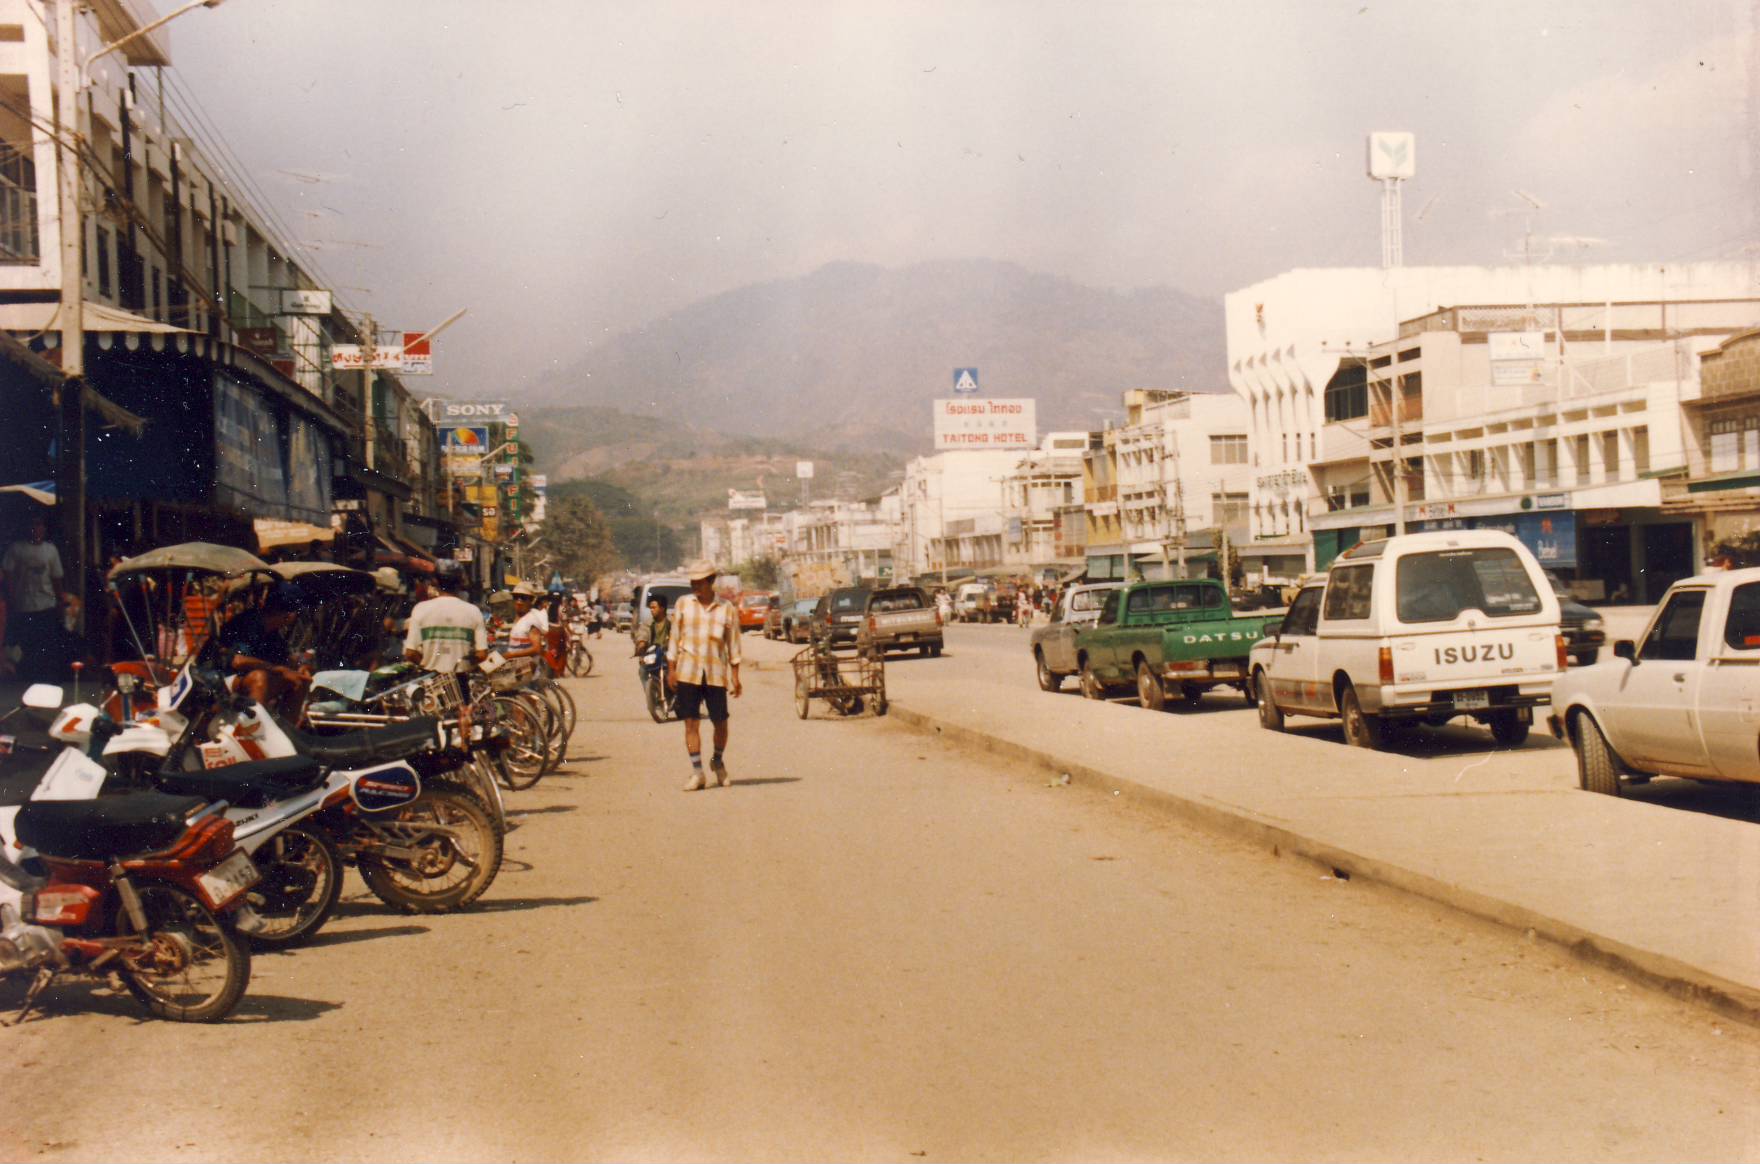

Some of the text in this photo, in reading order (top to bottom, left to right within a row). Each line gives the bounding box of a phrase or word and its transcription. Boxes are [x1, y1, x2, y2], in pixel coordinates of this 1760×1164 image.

[446, 404, 505, 416] SONY
[943, 433, 1027, 443] TAITONG HOTEL
[1183, 631, 1264, 644] DATSU
[1434, 643, 1514, 665] ISUZU
